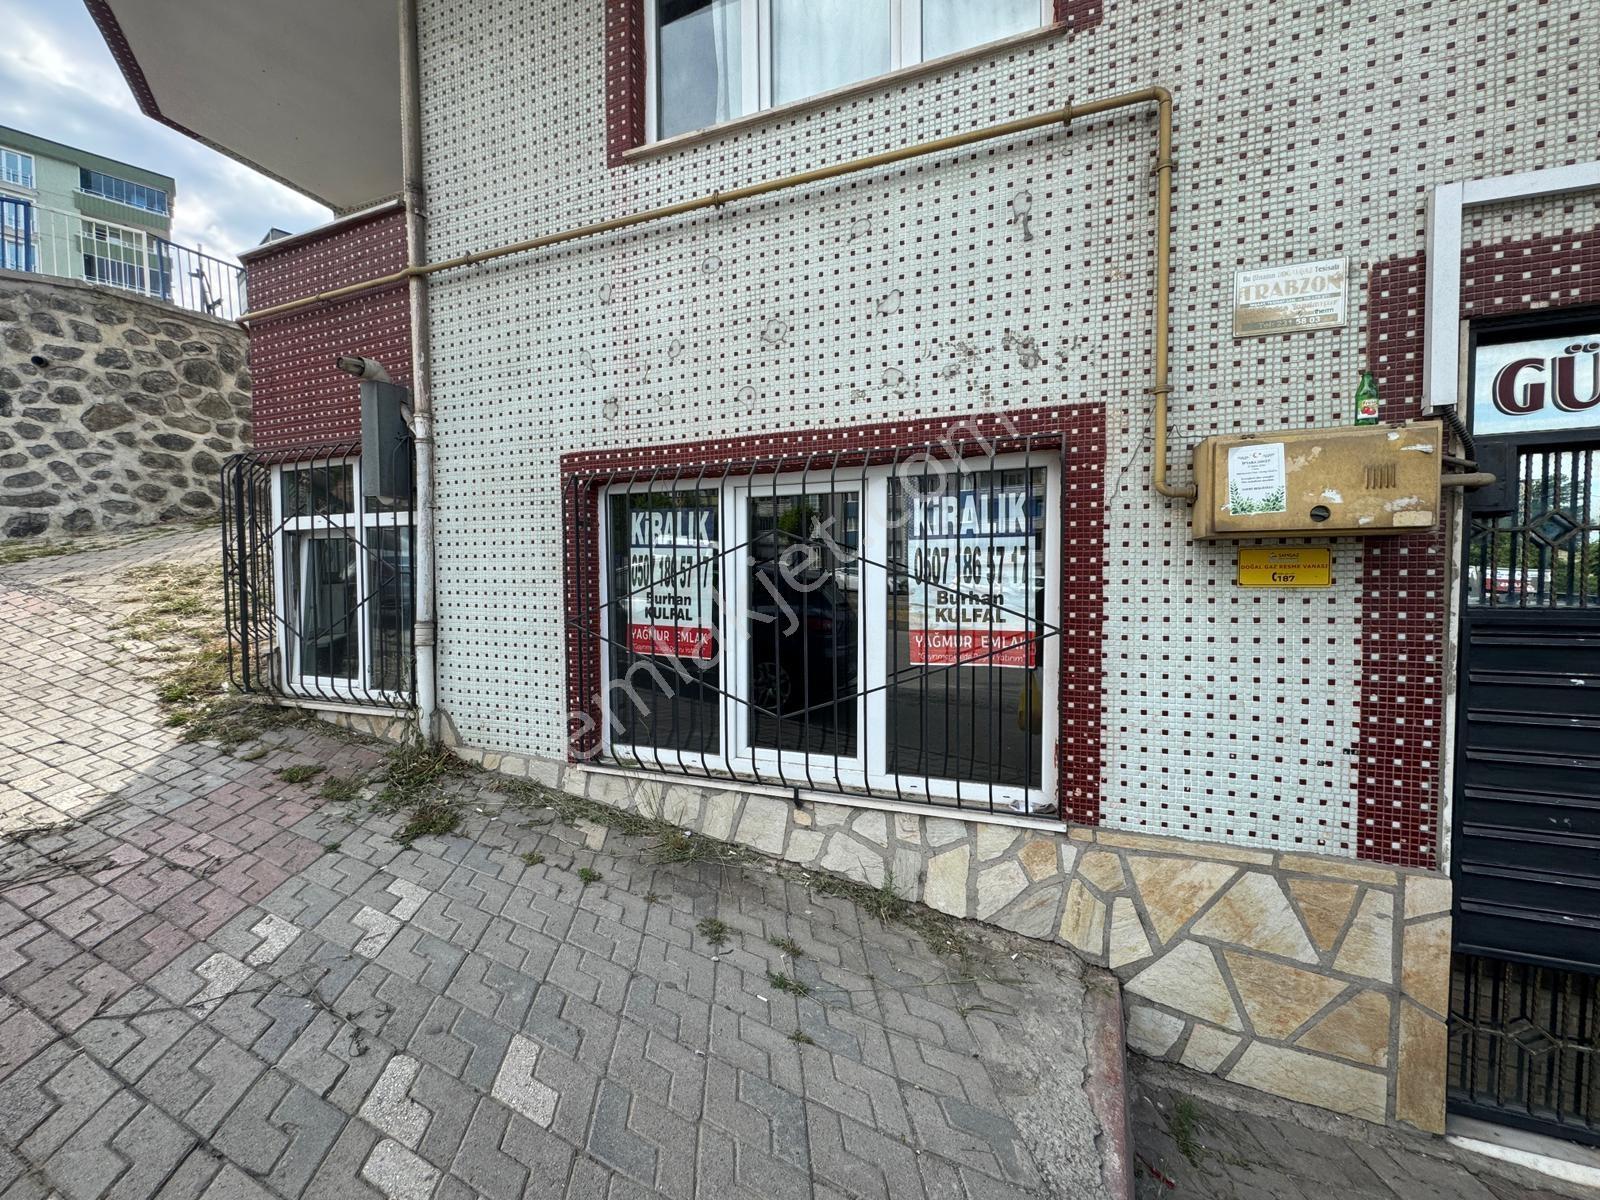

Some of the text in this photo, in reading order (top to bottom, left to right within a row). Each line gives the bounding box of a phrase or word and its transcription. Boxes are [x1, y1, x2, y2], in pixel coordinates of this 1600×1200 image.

[1241, 273, 1343, 300] TRABZON
[1296, 317, 1308, 325] 58
[680, 556, 693, 588] 57
[936, 591, 1004, 605] Burhan
[935, 608, 1006, 623] KULFAL
[915, 632, 972, 648] YAĞMUR
